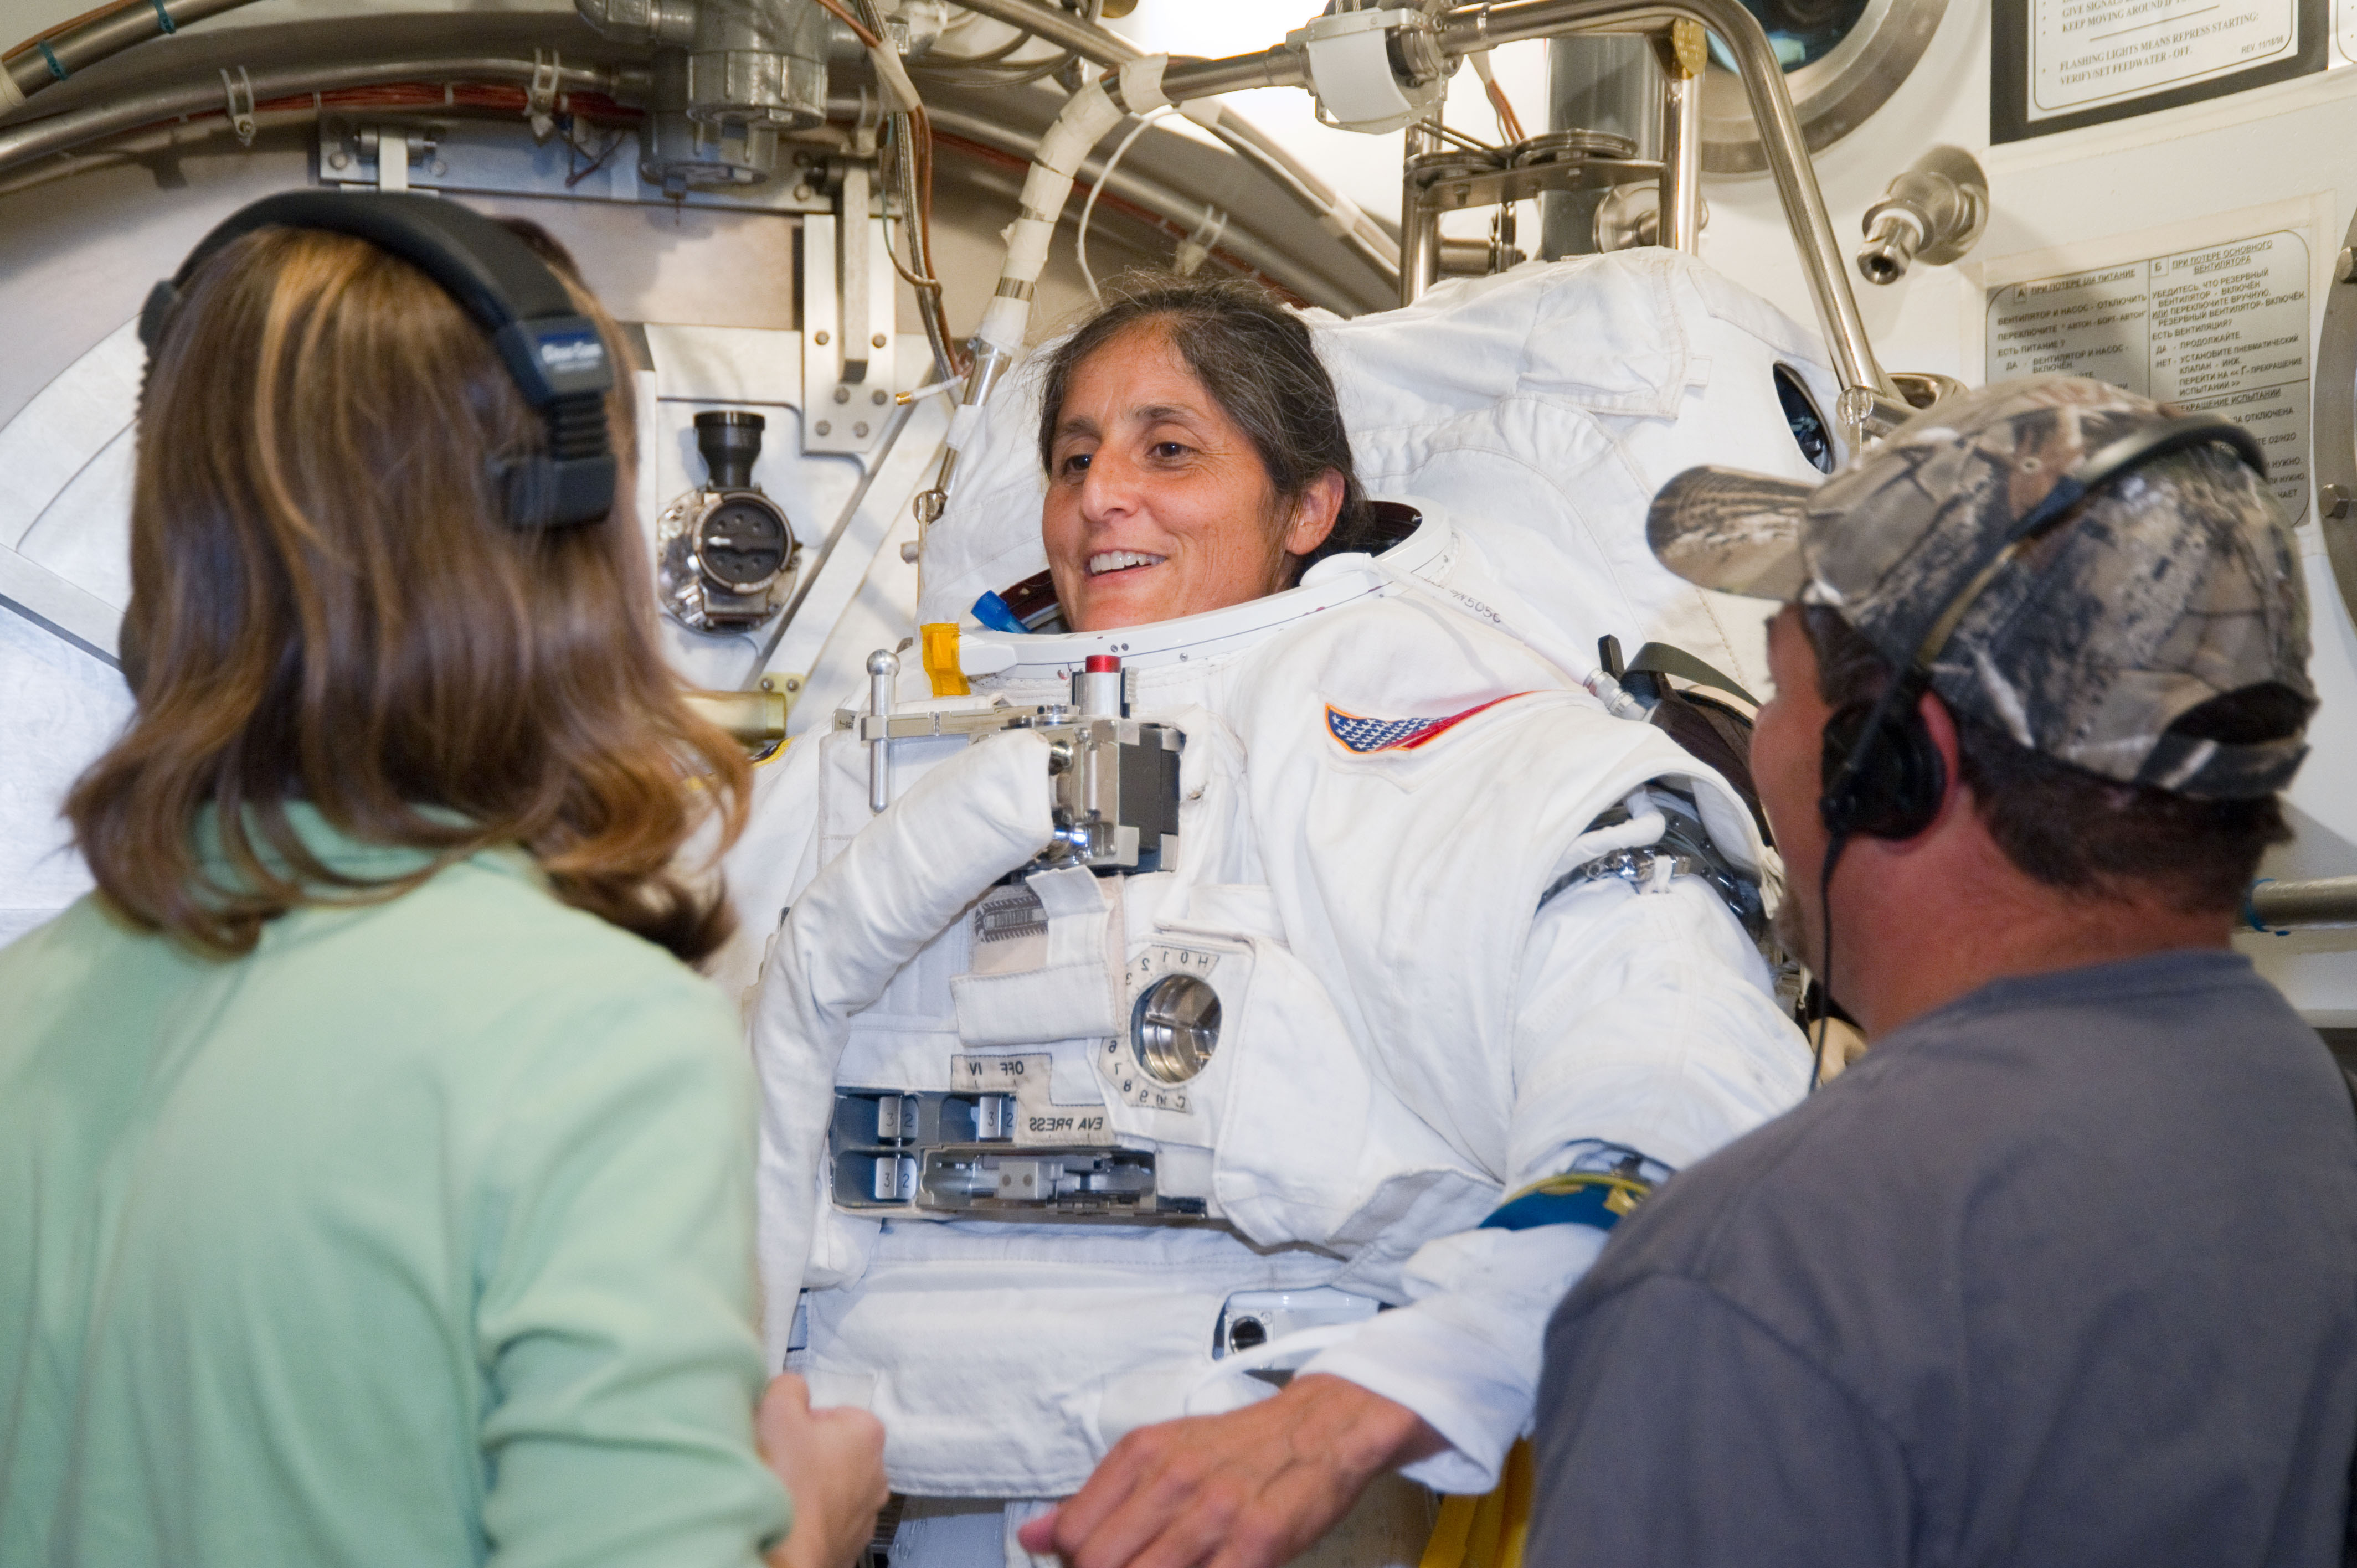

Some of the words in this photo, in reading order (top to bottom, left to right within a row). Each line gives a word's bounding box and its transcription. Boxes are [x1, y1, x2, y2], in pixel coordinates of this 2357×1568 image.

[2062, 4, 2083, 17] GIVE
[2062, 18, 2086, 32] KEEP
[2087, 9, 2124, 25] MOVING
[2060, 51, 2104, 71] FLASHING
[2106, 44, 2139, 61] LIGHTS
[2141, 35, 2171, 51] MEANS
[2173, 24, 2211, 44] REPRESS
[2212, 11, 2260, 32] STARTING:
[2241, 44, 2257, 54] REV.
[2060, 65, 2111, 85] VERIFY/SET
[2113, 51, 2167, 74] FEEDWATER
[2173, 45, 2194, 57] OFF.
[2172, 257, 2189, 270] ПРИ
[2191, 251, 2221, 266] ПОТЕРЕ
[2224, 240, 2273, 258] ОСНОВНОГО
[2155, 261, 2162, 271] Б
[2194, 255, 2251, 275] ВЕНТИЛЯТОРА
[2031, 284, 2049, 295] ПРИ
[2050, 278, 2081, 293] ПОТЕРЕ
[2098, 269, 2136, 283] ПИТАНИЕ
[2202, 278, 2219, 288] ЧТО
[2221, 267, 2269, 284] РЕЗЕРВНЫЙ
[2018, 288, 2025, 298] А
[2158, 291, 2211, 307] ВЕНТИЛЯТОР
[1998, 310, 2051, 326] ВЕНТИЛЯТОР
[2060, 304, 2089, 315] НАСОС
[2097, 294, 2148, 310] ОТКЛЮЧИТЬ
[2152, 309, 2168, 320] ИЛИ
[2170, 297, 2229, 314] ПЕРЕКЛЮЧИТЕ
[1998, 324, 2058, 341] ПЕРЕКЛЮЧИТЕ
[2152, 331, 2173, 341] ЕСТЬ
[2175, 318, 2233, 337] ВЕНТИЛЯЦИЯ?
[1998, 347, 2019, 357] ЕСТЬ
[2021, 340, 2058, 353] ПИТАНИЕ
[2156, 345, 2167, 355] ДА
[2156, 358, 2171, 367] НЕТ
[2180, 347, 2232, 363] УСТАНОВИТЕ
[2234, 333, 2299, 353] ПНЕВМАТИЧЕСКИЙ
[2006, 362, 2018, 371] ДА
[2033, 349, 2086, 365] ВЕНТИЛЯТОР
[2095, 344, 2124, 355] НАСОС
[2179, 362, 2212, 374] КЛАПАН
[2217, 370, 2229, 379] НА
[2245, 406, 2294, 422] ОТКЛЮЧЕНА
[886, 1113, 894, 1127] 3
[904, 1113, 913, 1128] 2
[988, 1111, 995, 1127] 3
[1006, 1112, 1013, 1128] 2
[883, 1173, 891, 1188] 3
[902, 1174, 910, 1188] 2
